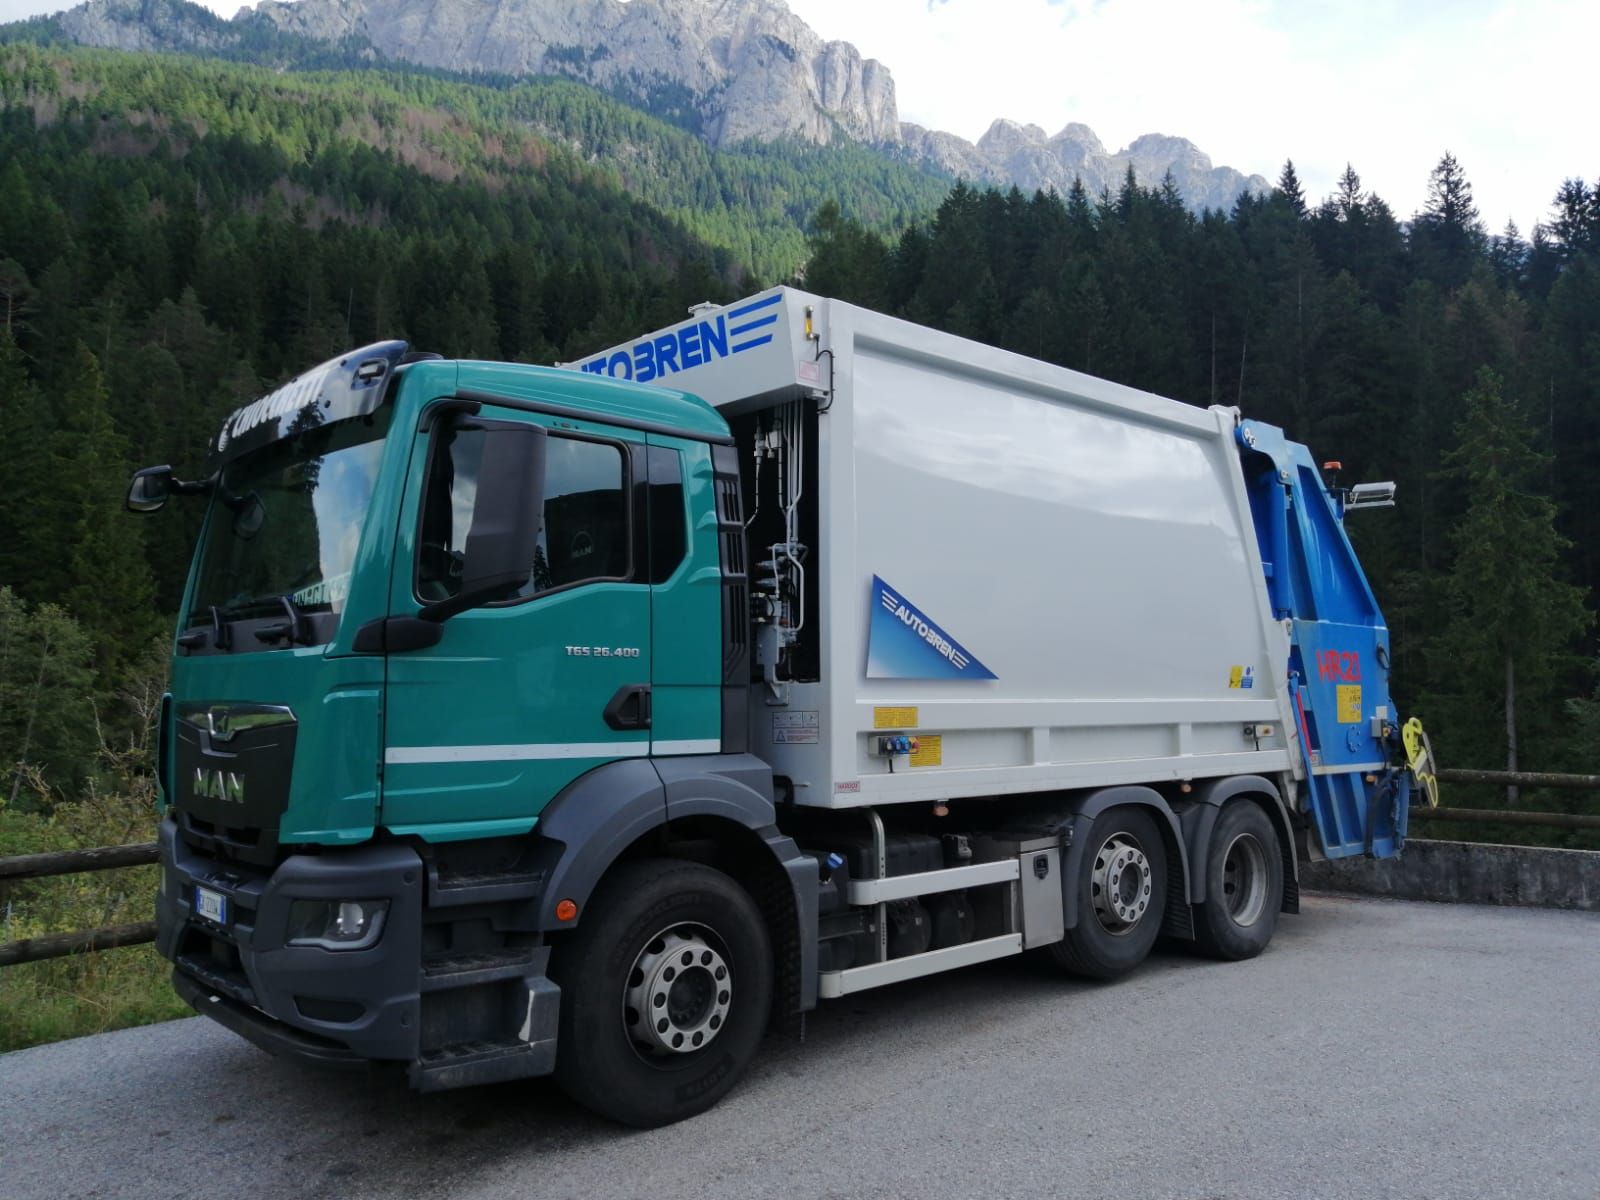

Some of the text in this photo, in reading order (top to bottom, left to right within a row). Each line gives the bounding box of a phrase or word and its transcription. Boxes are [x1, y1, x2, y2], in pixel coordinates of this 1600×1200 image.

[895, 605, 956, 661] AUTOBREN
[593, 647, 640, 657] 26.400
[193, 767, 245, 804] MAN
